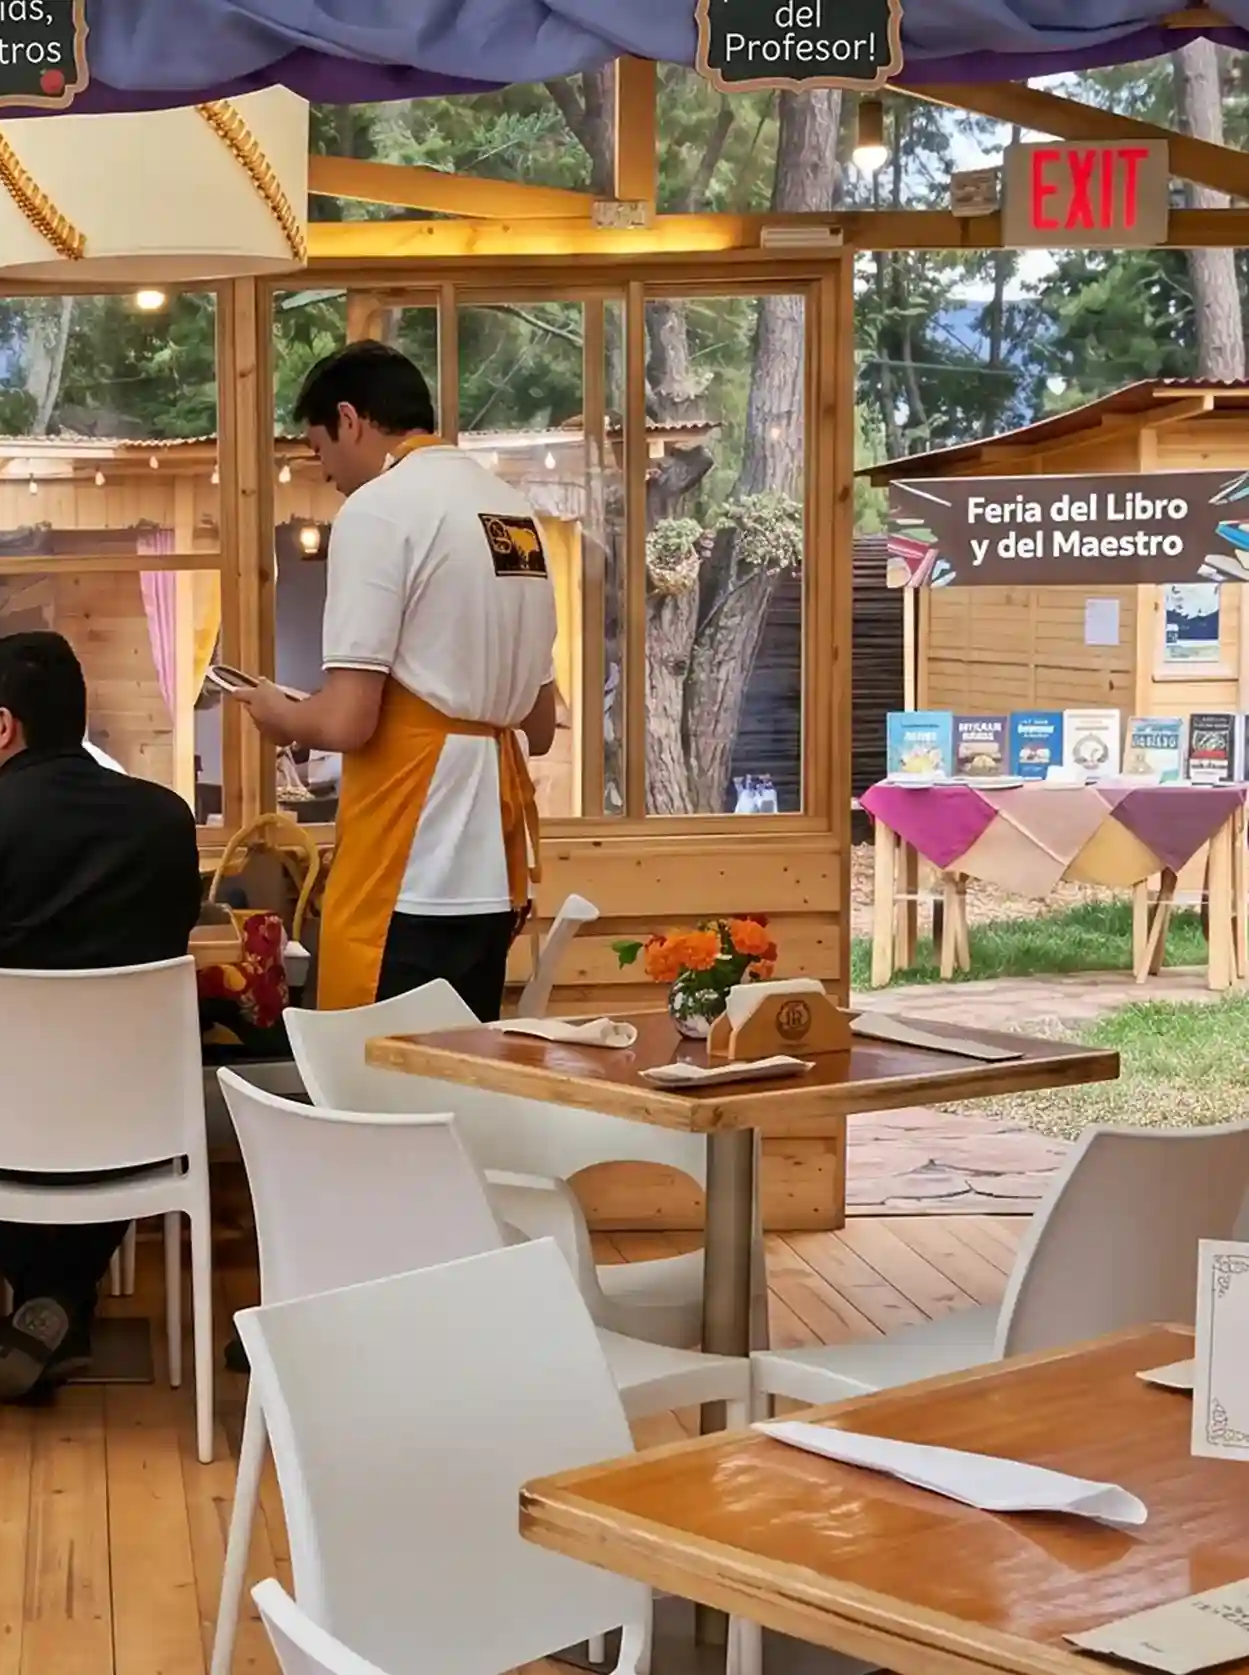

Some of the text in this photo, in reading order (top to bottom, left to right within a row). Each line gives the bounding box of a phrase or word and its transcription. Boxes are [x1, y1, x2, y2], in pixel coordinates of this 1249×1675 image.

[775, 0, 821, 28] del
[726, 32, 875, 62] Profesor!
[1031, 148, 1149, 231] EXIT
[967, 492, 1189, 524] Feria del Libro
[970, 531, 1184, 566] y del Maestro
